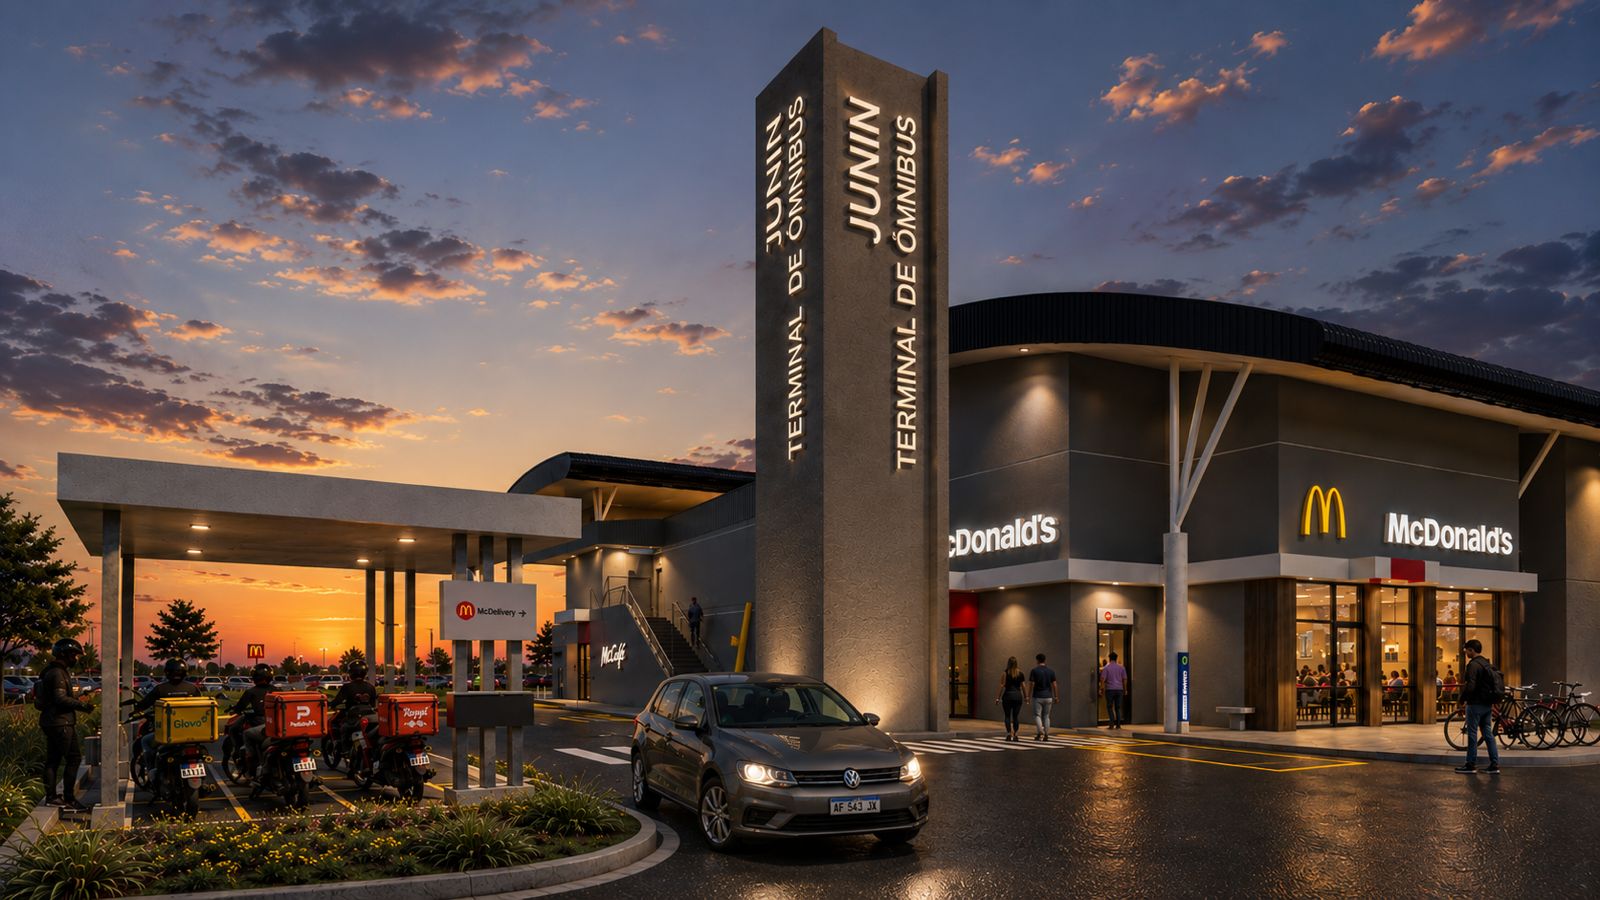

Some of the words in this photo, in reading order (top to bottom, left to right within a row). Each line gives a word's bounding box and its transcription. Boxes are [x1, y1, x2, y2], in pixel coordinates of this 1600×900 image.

[766, 112, 782, 253] JUNIN
[849, 95, 882, 245] JUNIN
[788, 249, 803, 295] DE
[896, 262, 917, 306] DE
[788, 306, 803, 460] TERMINAL
[896, 317, 917, 470] TERMINAL
[948, 514, 1057, 558] cDonald's
[1386, 512, 1513, 555] McDonald's
[477, 603, 516, 617] McDelivery
[833, 802, 844, 813] AF
[867, 801, 877, 811] JX
